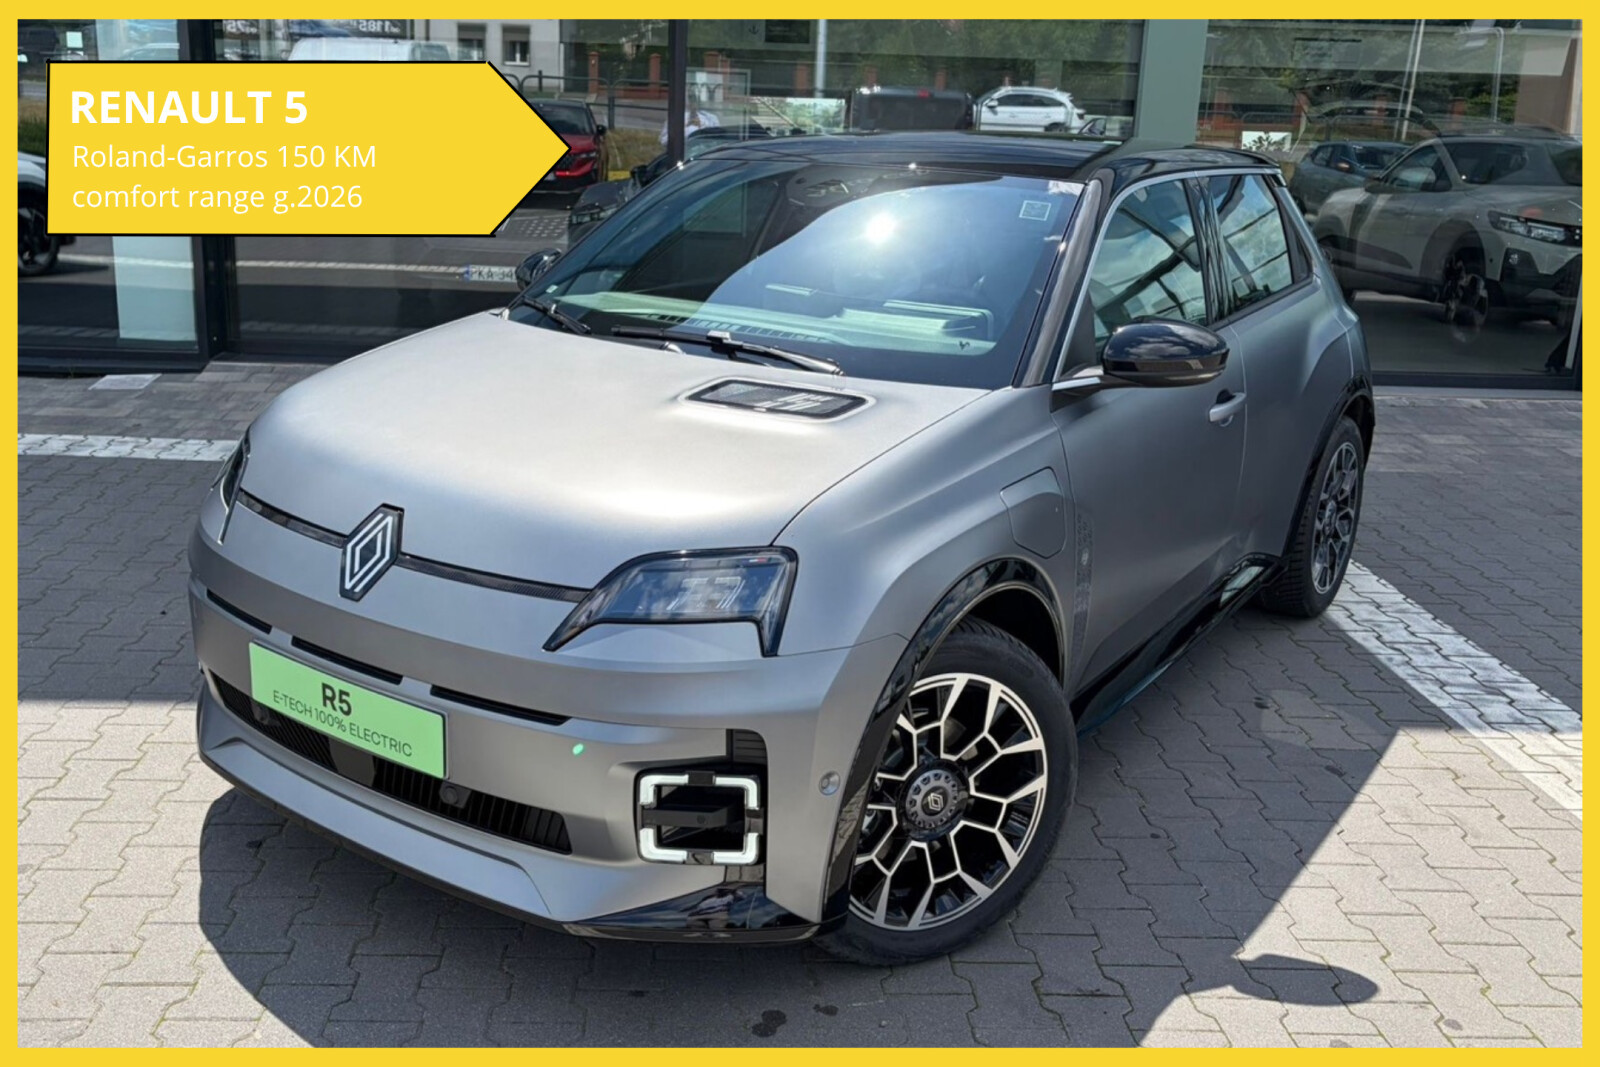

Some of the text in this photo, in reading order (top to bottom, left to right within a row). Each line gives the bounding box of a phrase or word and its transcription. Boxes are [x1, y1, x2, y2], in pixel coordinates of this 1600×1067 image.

[273, 689, 413, 757] E-TECH 100% ELECTRIC
[321, 682, 352, 716] R5
